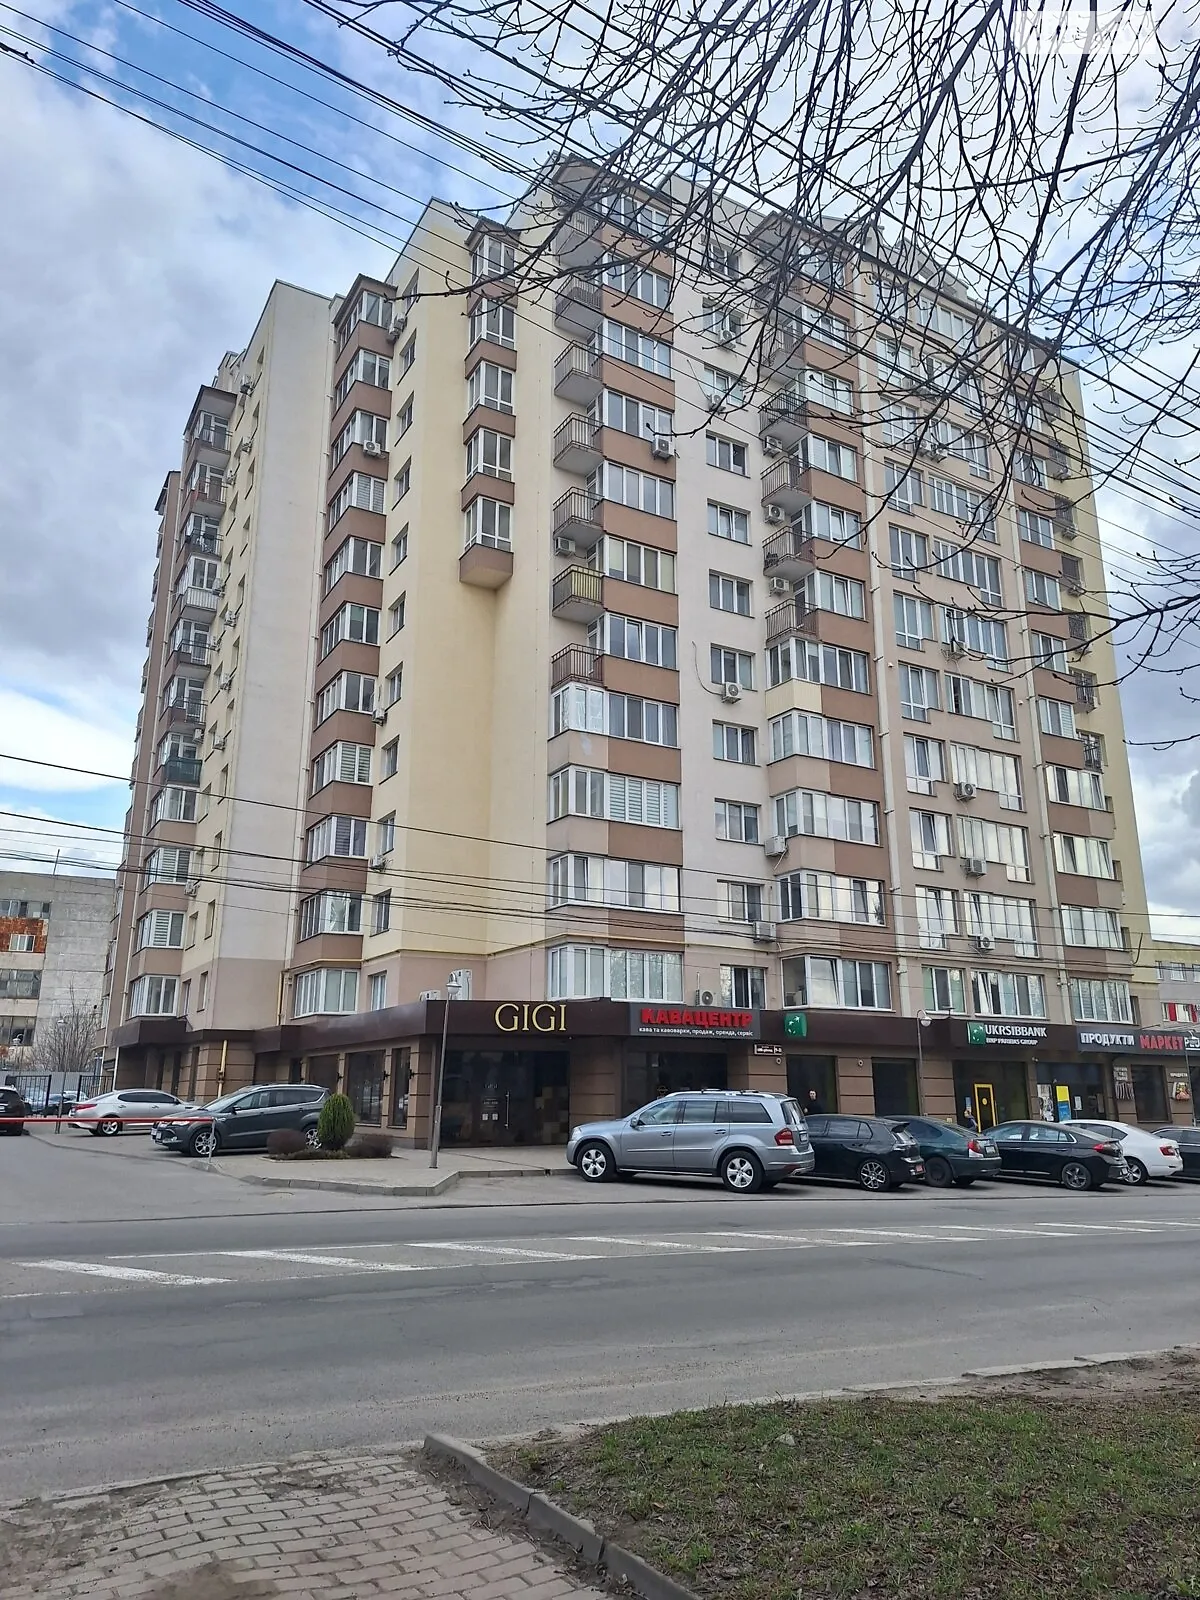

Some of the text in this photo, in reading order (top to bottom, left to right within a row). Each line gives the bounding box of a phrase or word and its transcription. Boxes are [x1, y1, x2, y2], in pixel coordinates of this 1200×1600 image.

[495, 1003, 566, 1031] GIGI
[641, 1008, 752, 1027] КАВАЦЕНТР
[984, 1024, 1048, 1037] UKRSIBBANK
[1080, 1032, 1135, 1047] ПРОДУКТИ
[1139, 1034, 1184, 1050] МАРКЕТ
